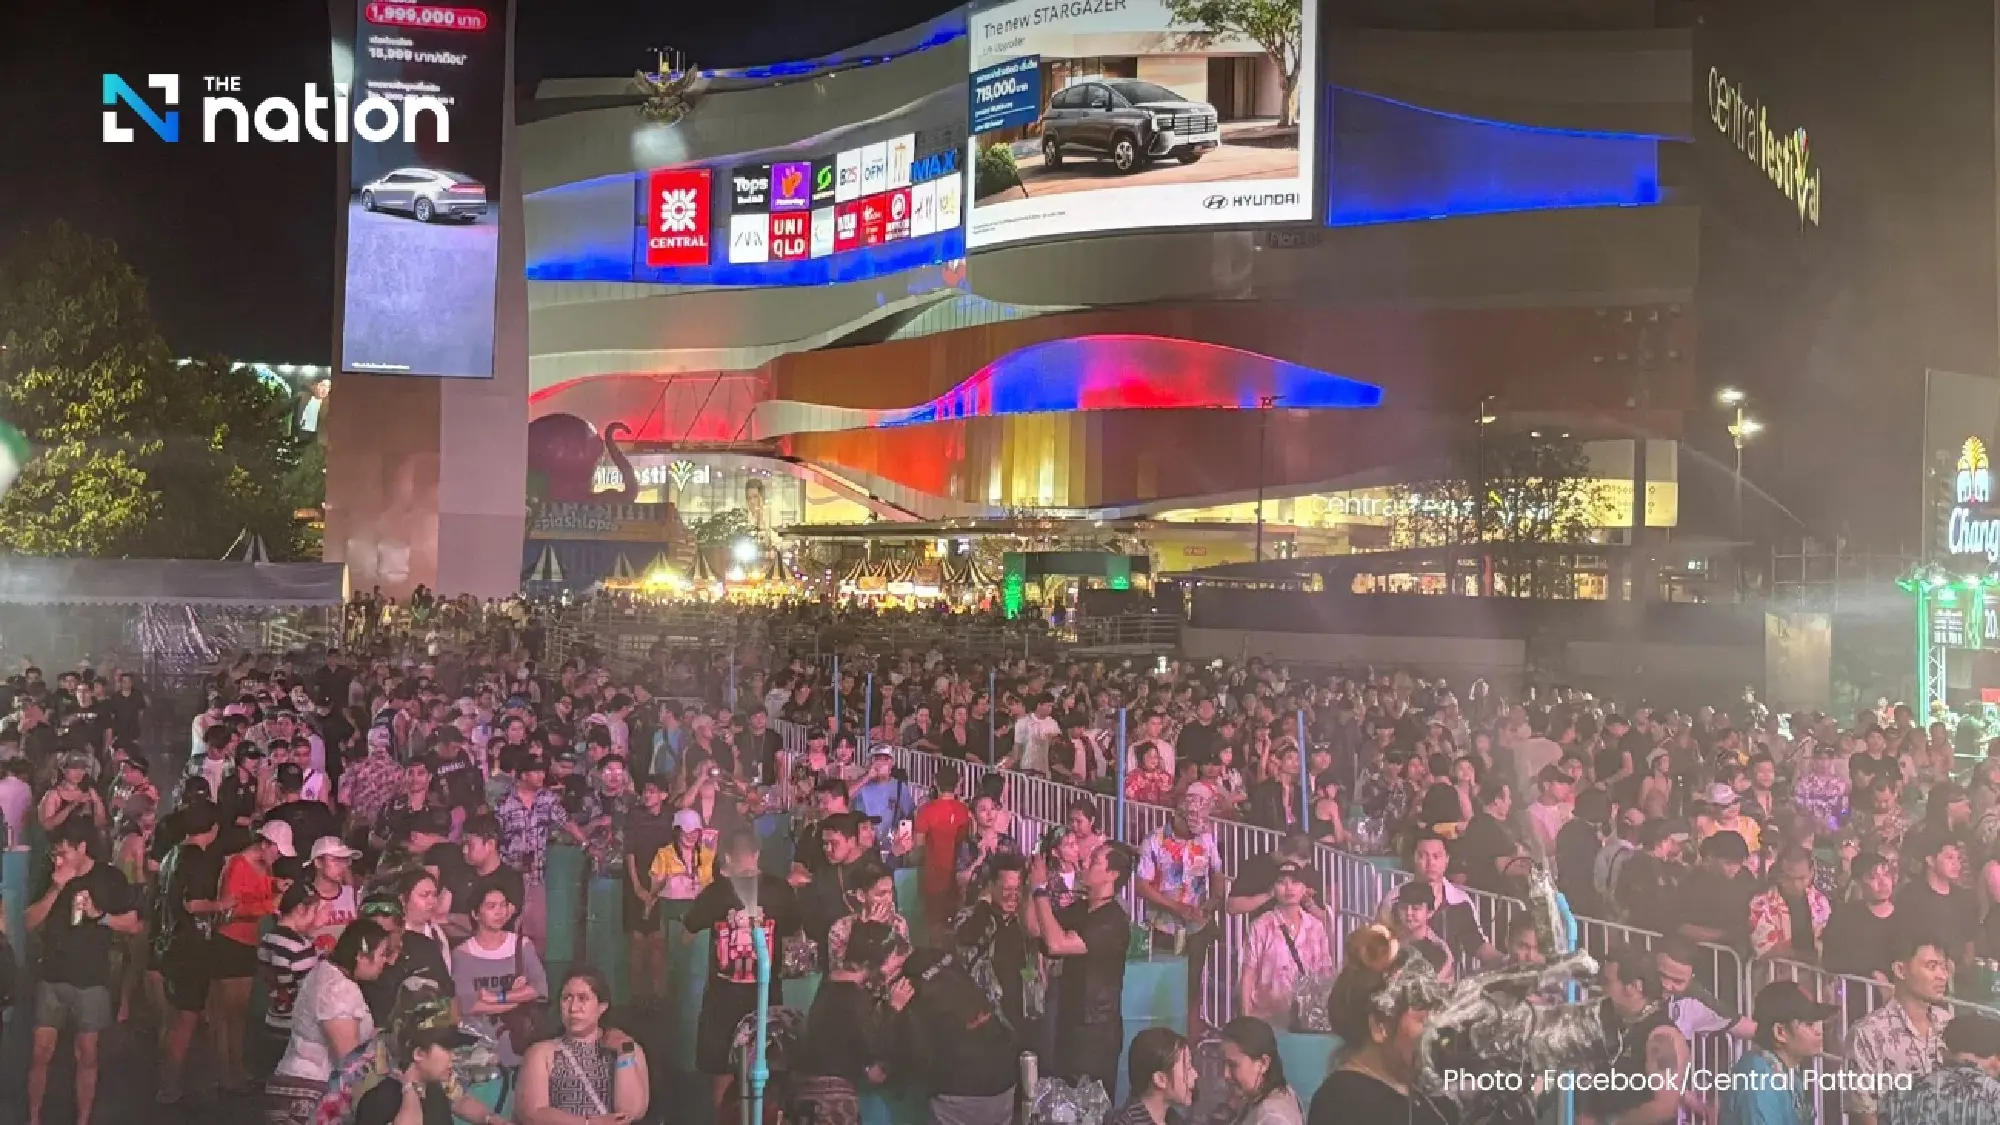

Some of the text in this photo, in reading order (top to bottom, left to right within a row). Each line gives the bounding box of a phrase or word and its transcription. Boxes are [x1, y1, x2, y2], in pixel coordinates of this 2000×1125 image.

[984, 0, 1127, 39] The new STARGAZER
[733, 176, 769, 194] Tops
[1231, 192, 1301, 207] HYUNDAI
[773, 218, 803, 235] UNI
[650, 235, 707, 249] CENTRAL
[772, 238, 805, 257] QLO
[1949, 507, 1999, 563] Chang
